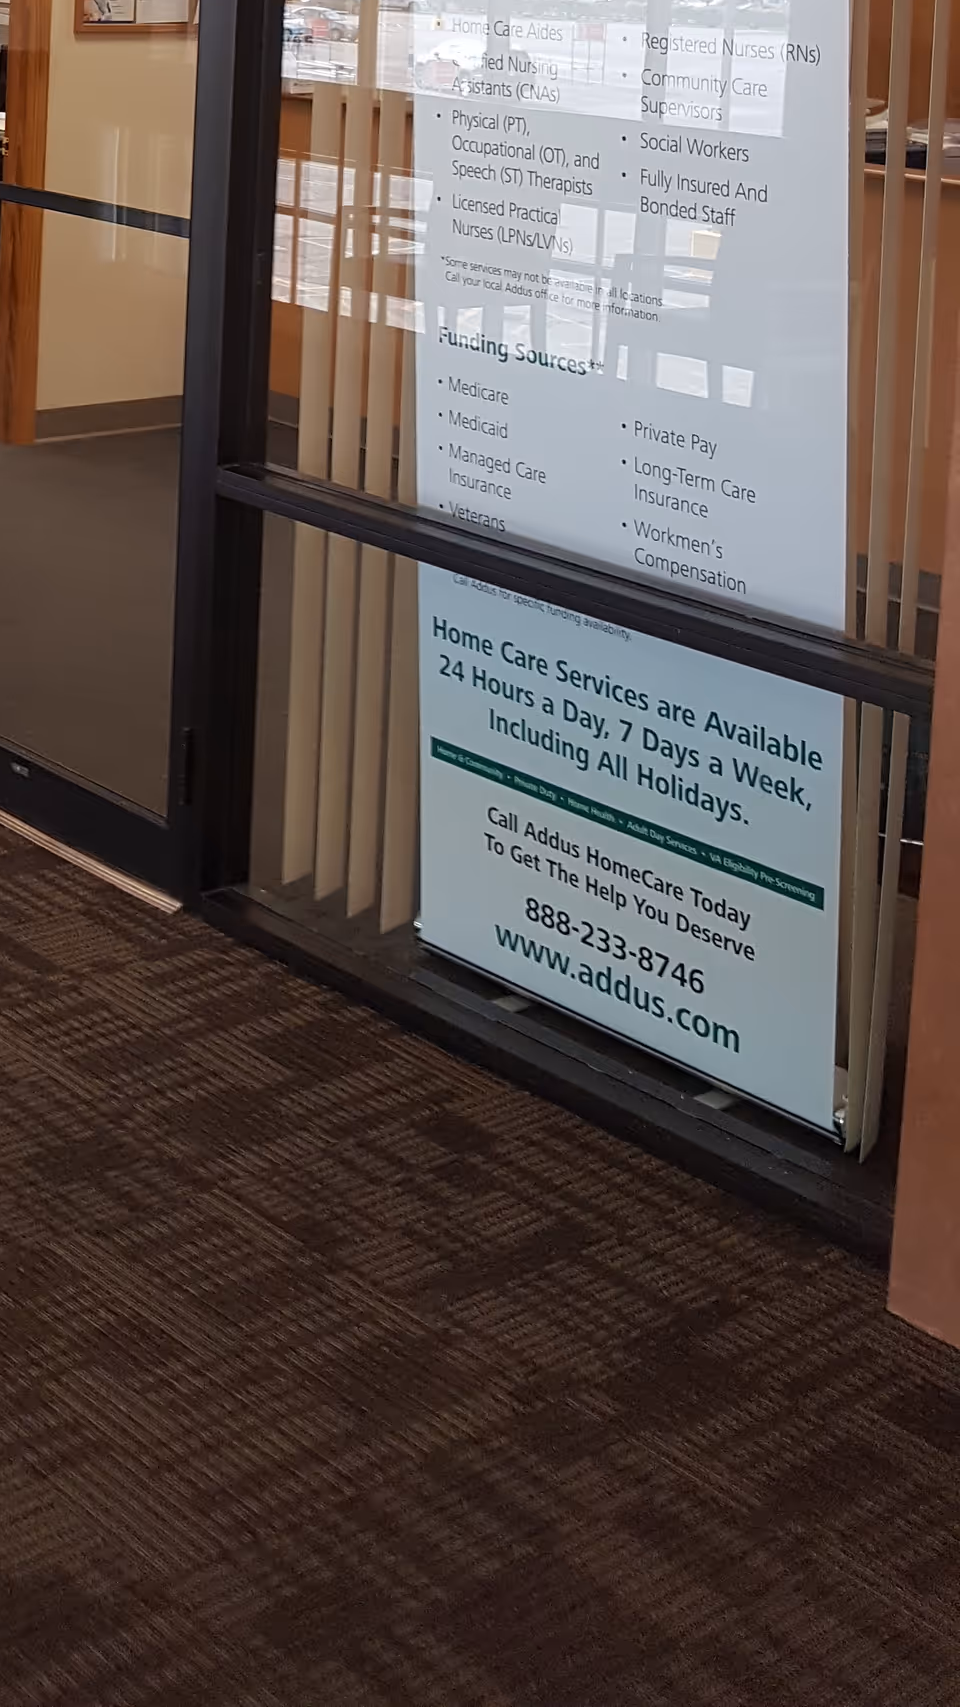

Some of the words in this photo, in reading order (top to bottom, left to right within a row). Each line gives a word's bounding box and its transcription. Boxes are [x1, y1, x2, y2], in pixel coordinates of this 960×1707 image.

[452, 17, 490, 36] Home
[493, 20, 523, 38] Care
[526, 23, 564, 42] Aides
[641, 32, 717, 55] Registered
[722, 38, 775, 60] Nurses
[780, 41, 821, 67] (RNs)
[508, 55, 558, 81] Nursing
[641, 68, 727, 98] Community
[732, 77, 768, 98] Care
[516, 81, 560, 104] (CNAs)
[641, 96, 723, 122] Supervisors
[452, 109, 499, 131] Physical
[503, 115, 530, 136] (PT),
[452, 135, 535, 161] Occupational
[539, 145, 569, 168] (OT),
[573, 152, 600, 170] and
[640, 132, 682, 153] Social
[686, 137, 749, 162] Workers
[452, 160, 496, 182] Speech
[500, 166, 523, 187] (ST)
[527, 170, 593, 195] Therapists
[640, 168, 672, 193] Fully
[677, 173, 730, 197] Insured
[735, 182, 768, 203] And
[452, 193, 505, 216] Licensed
[509, 202, 562, 226] Practical
[640, 196, 697, 220] Bonded
[702, 205, 736, 226] Staff
[452, 218, 494, 240] Nurses
[497, 225, 573, 255] (LPNs/LVNs)
[445, 271, 460, 283] Call
[462, 276, 481, 287] your
[483, 279, 503, 291] local
[505, 282, 533, 298] Addus
[534, 288, 559, 303] office
[577, 298, 600, 311] more
[469, 262, 501, 276] services
[503, 268, 521, 282] may
[524, 272, 540, 283] not
[607, 286, 617, 298] all
[438, 326, 508, 363] Funding
[448, 376, 509, 406] Medicare
[448, 409, 508, 439] Medicaid
[634, 420, 685, 449] Private
[691, 433, 717, 460] Pay
[448, 443, 511, 474] Managed
[515, 461, 546, 485] Care
[634, 456, 715, 492] Long-Term
[721, 479, 756, 504] Care
[449, 467, 512, 500] Insurance
[634, 483, 709, 518] Insurance
[448, 500, 506, 533] Veterans
[634, 547, 746, 595] Compensation
[432, 615, 493, 657] Home
[500, 641, 549, 676] Care
[555, 659, 649, 712] Services
[657, 699, 696, 728] are
[704, 711, 823, 771] Available
[439, 654, 465, 682] 24
[472, 665, 535, 708] Hours
[541, 695, 554, 716] a
[562, 698, 610, 739] Day,
[618, 718, 633, 743] 7
[642, 727, 700, 769] Days
[708, 755, 723, 777] a
[732, 757, 812, 812] Week,
[489, 708, 589, 771] Including
[597, 751, 628, 781] All
[637, 763, 749, 825] Holidays.
[488, 806, 518, 833] Call
[524, 821, 580, 859] Addus
[587, 845, 684, 902] HomeCare
[690, 886, 751, 932] Today
[484, 831, 504, 856] To
[510, 845, 542, 873] Get
[545, 858, 579, 889] The
[585, 875, 627, 910] Help
[632, 894, 669, 926] You
[676, 912, 755, 962] Deserve
[525, 897, 705, 994] 888-233-8746
[495, 923, 740, 1054] www.addus.com
